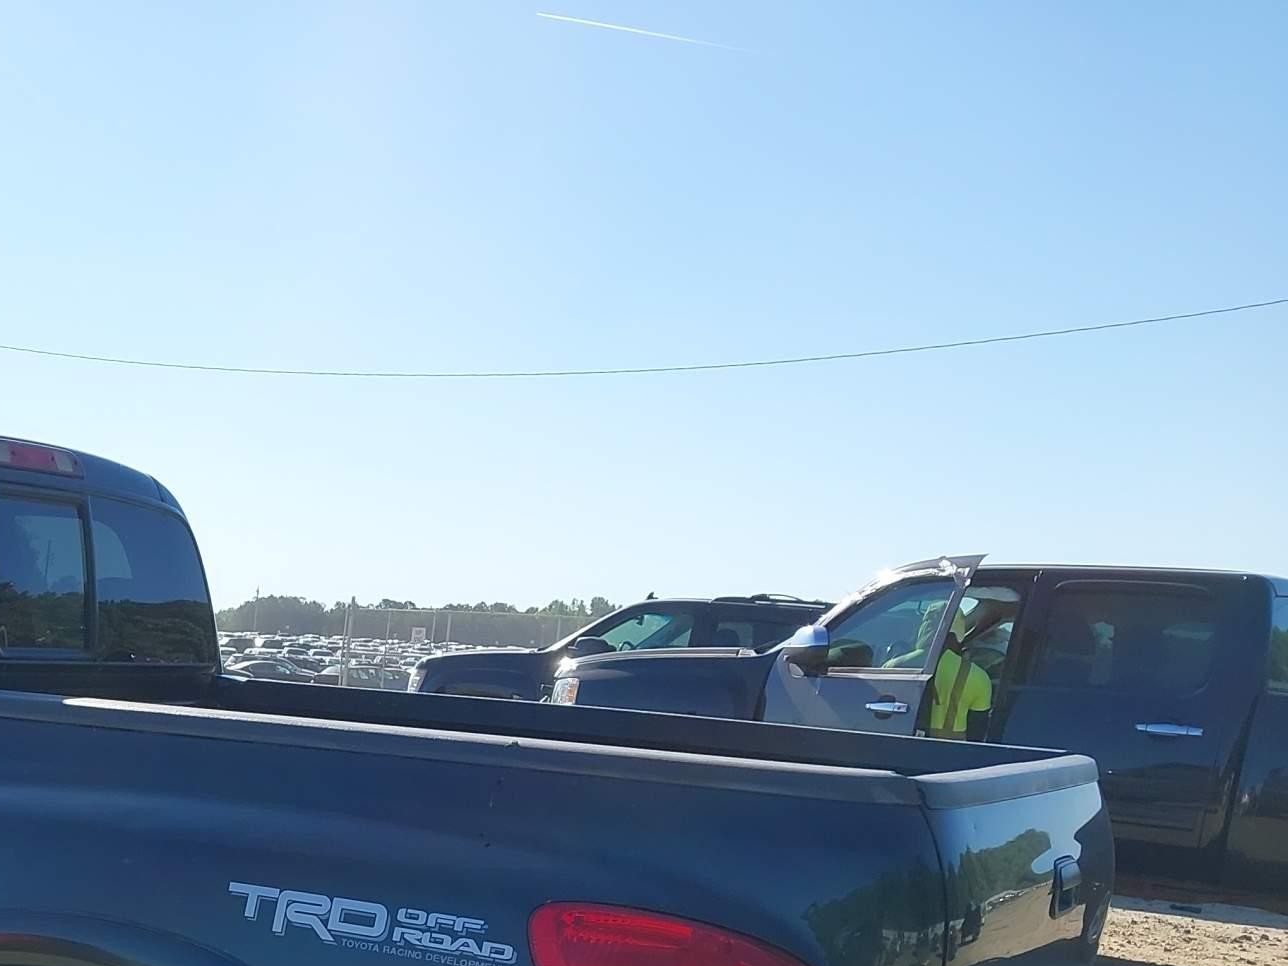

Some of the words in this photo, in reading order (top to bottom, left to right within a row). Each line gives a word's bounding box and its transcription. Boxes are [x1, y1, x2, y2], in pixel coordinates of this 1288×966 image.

[228, 881, 391, 945] TRD
[396, 907, 488, 934] OFF
[340, 937, 379, 953] TOYOTA
[383, 944, 422, 961] RACING
[392, 926, 517, 964] ROAD
